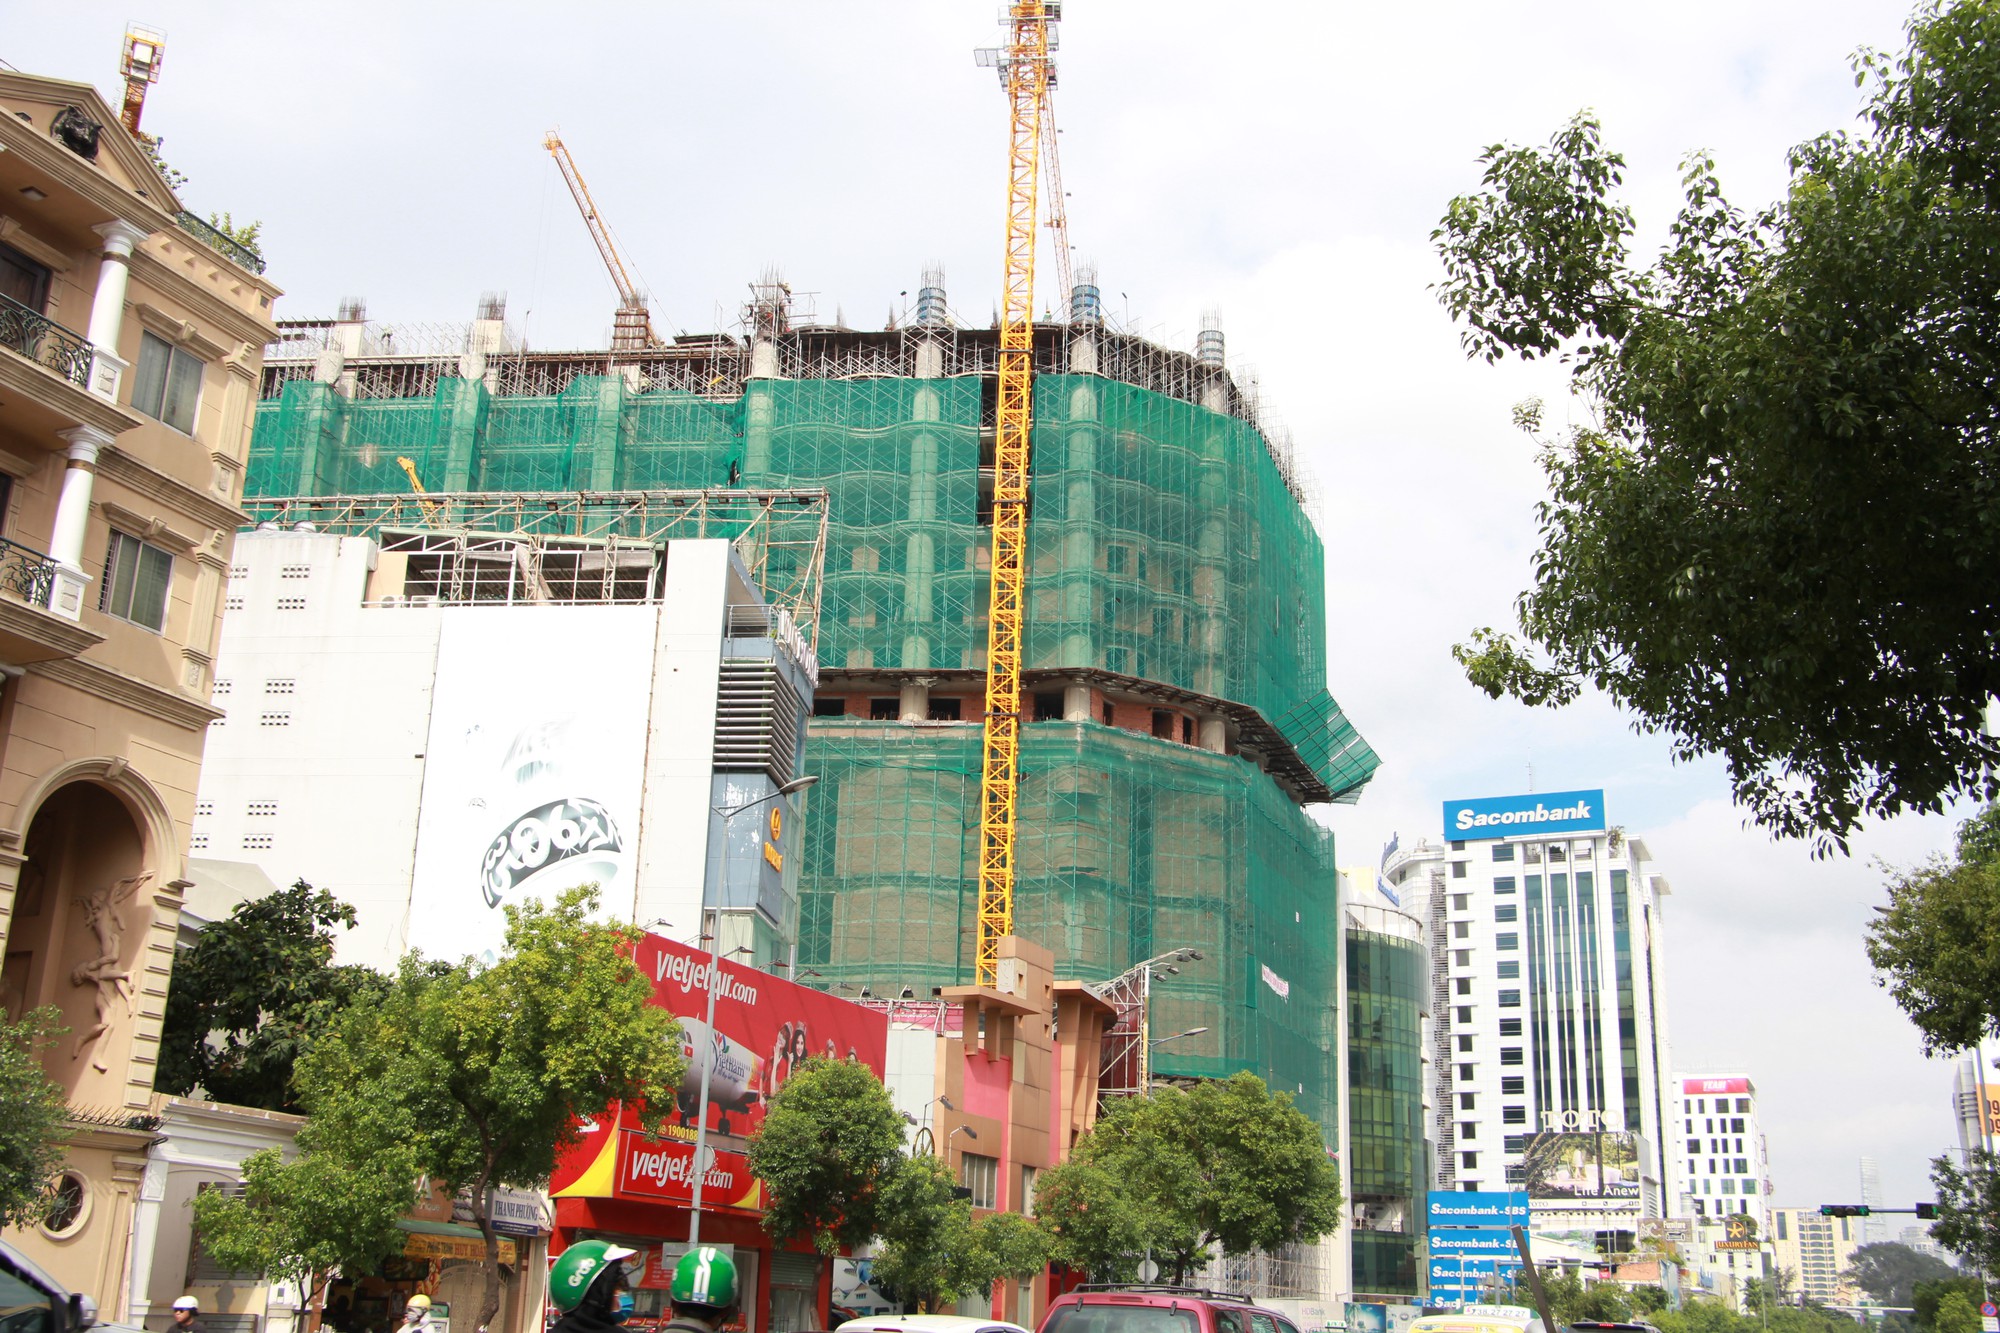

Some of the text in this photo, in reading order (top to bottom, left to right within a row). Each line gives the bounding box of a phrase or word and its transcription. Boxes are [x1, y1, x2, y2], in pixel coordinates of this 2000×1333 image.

[1456, 800, 1592, 830] Sacombank
[1540, 1109, 1621, 1129] TOTO
[1602, 1184, 1639, 1196] Anew
[568, 1258, 597, 1287] Grab
